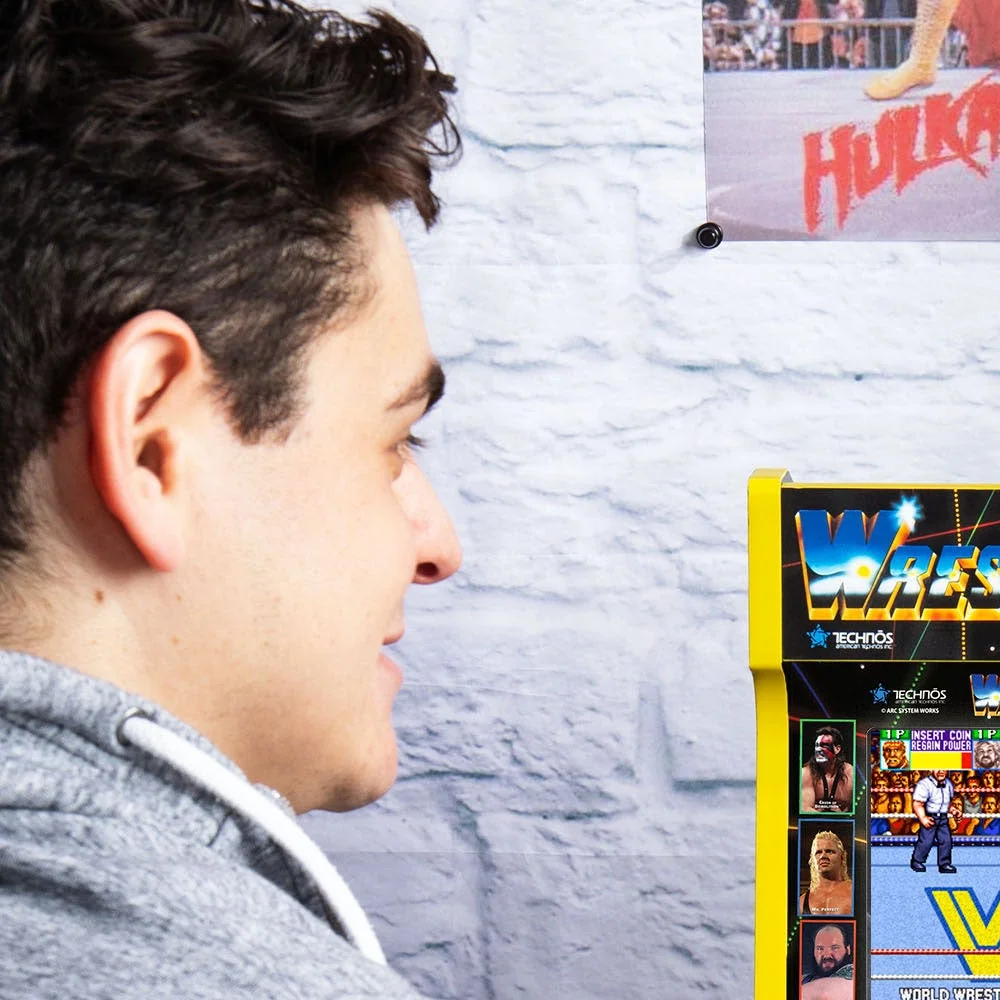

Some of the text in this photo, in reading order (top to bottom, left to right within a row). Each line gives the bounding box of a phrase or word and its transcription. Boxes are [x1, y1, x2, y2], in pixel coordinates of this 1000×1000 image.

[911, 730, 972, 740] INSERT COIN
[943, 741, 972, 751] POWER
[900, 987, 950, 1000] WORLD
